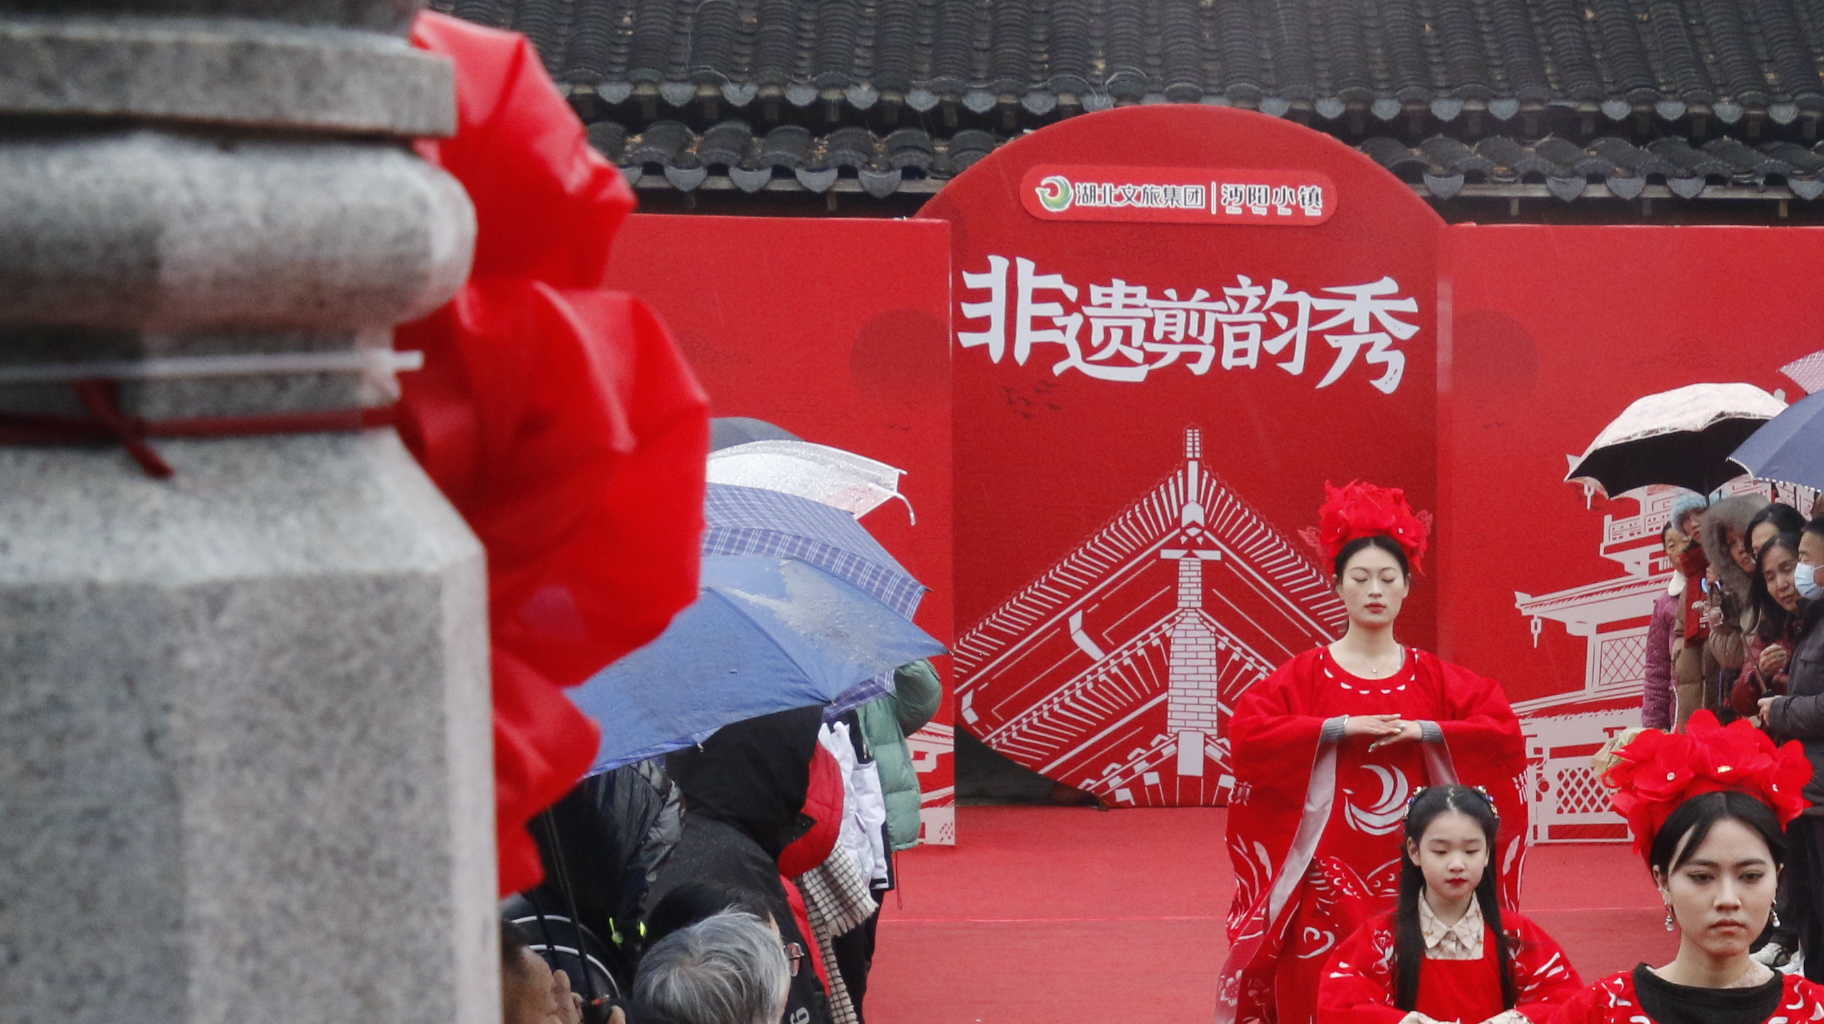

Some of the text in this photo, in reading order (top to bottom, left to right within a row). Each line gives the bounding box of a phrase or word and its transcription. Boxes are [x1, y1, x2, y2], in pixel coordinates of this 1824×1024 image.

[1075, 183, 1323, 212] 湖北文旅集团 沔阳小镇
[957, 255, 1421, 394] 非遗剪韵秀
